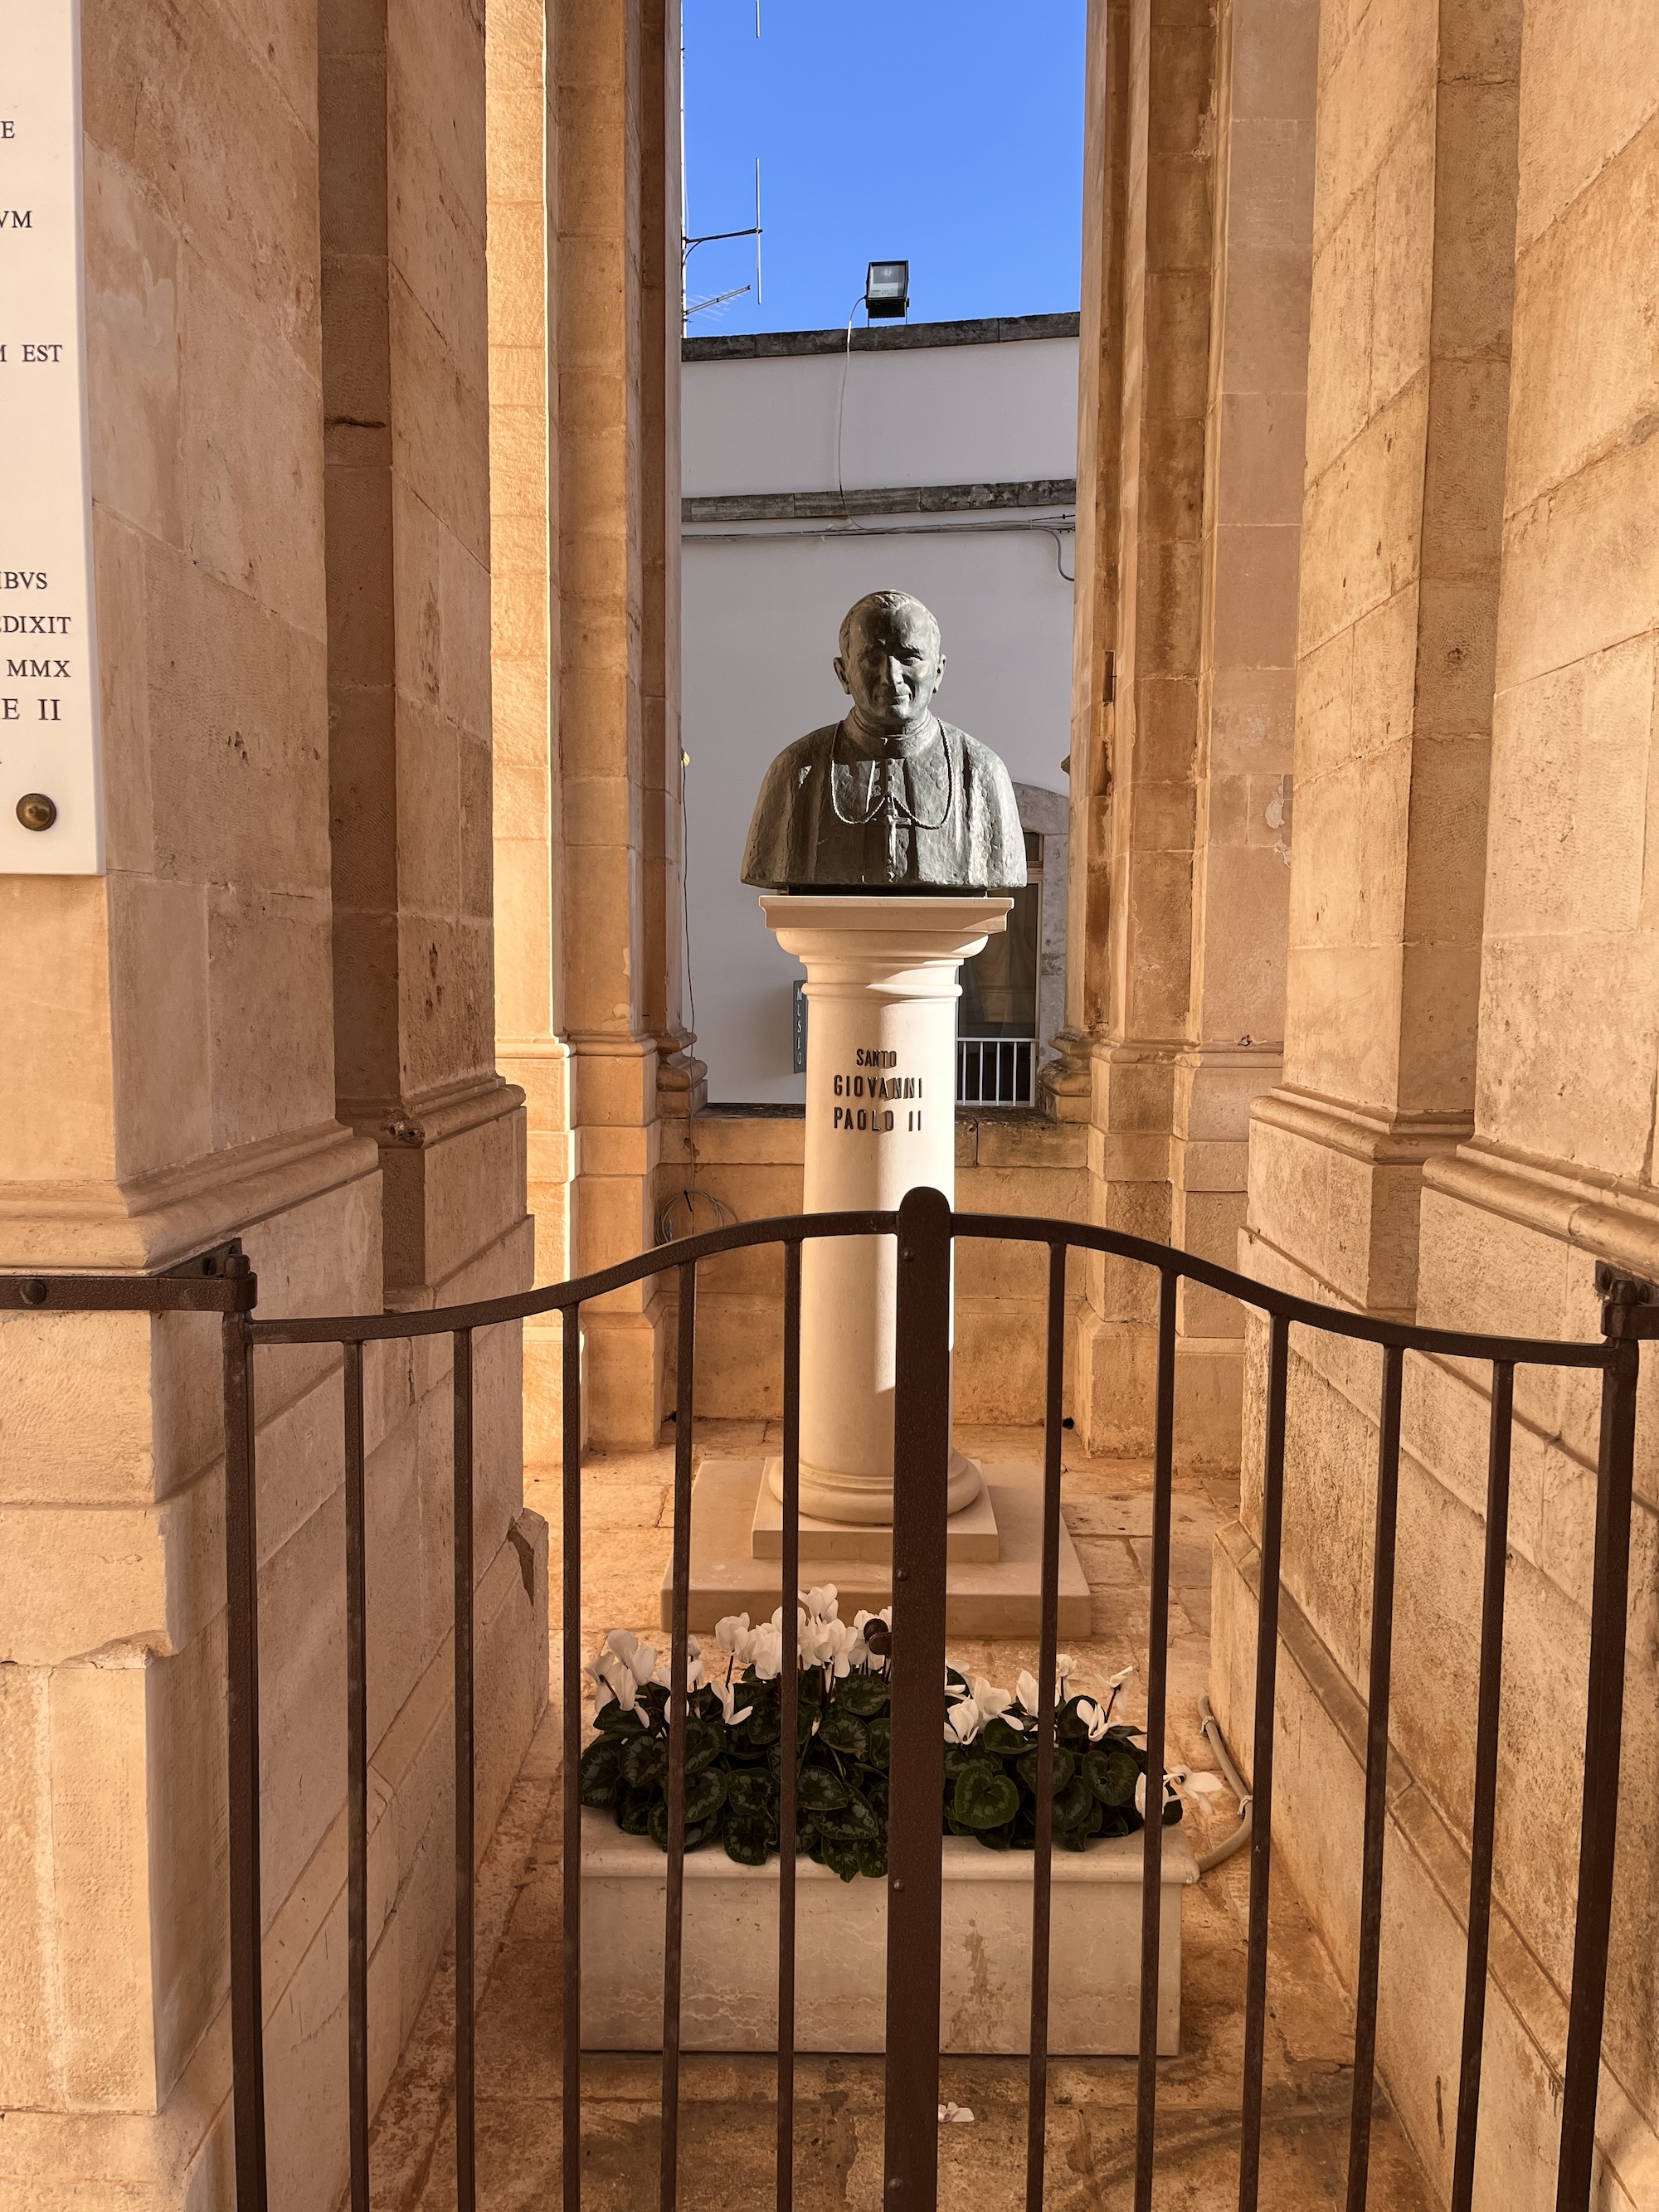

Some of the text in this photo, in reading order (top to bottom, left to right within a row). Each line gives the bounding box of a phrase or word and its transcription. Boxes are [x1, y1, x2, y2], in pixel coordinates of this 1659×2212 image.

[21, 343, 63, 362] EST
[0, 615, 71, 634] DIXIT
[7, 659, 71, 678] MMX
[1, 698, 61, 721] E II
[856, 1048, 897, 1067] SANTO
[834, 1074, 922, 1099] GIOVANNI
[834, 1106, 922, 1132] PAOLO II
